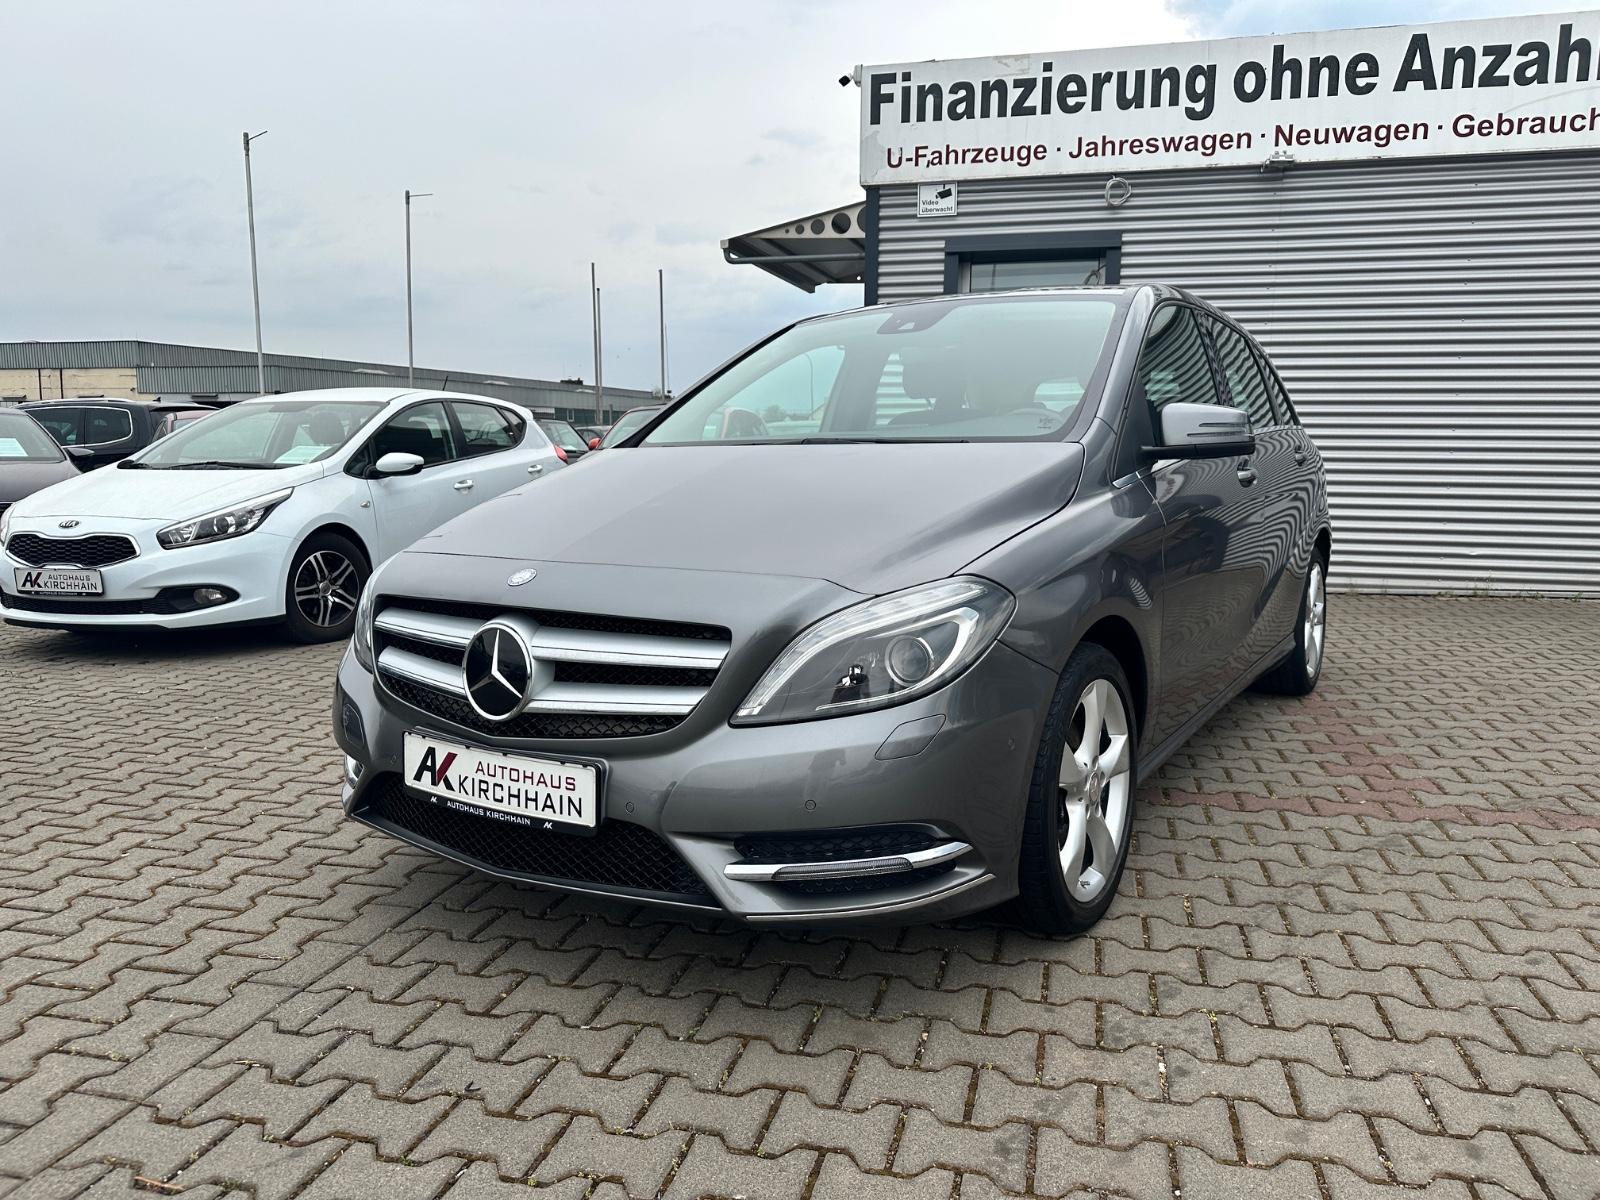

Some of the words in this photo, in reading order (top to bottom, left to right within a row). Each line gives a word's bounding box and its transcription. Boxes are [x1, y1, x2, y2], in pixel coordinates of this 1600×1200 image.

[870, 61, 1217, 125] Finanzierung
[1233, 44, 1380, 103] ohne
[1392, 23, 1600, 92] Anzah
[1068, 131, 1252, 159] Jahreswagen
[1274, 121, 1430, 148] Neuwagen
[921, 205, 953, 213] überwacht
[21, 571, 43, 588] AK
[43, 581, 98, 591] KIRCHHAIN
[48, 574, 91, 582] AUTOHAUS
[413, 746, 458, 792] AK
[475, 760, 576, 792] AUTOHAUS
[458, 774, 583, 818] KIRCHHAIN
[446, 800, 484, 816] AUTOHAUS
[486, 810, 531, 826] KIRCHHAIN
